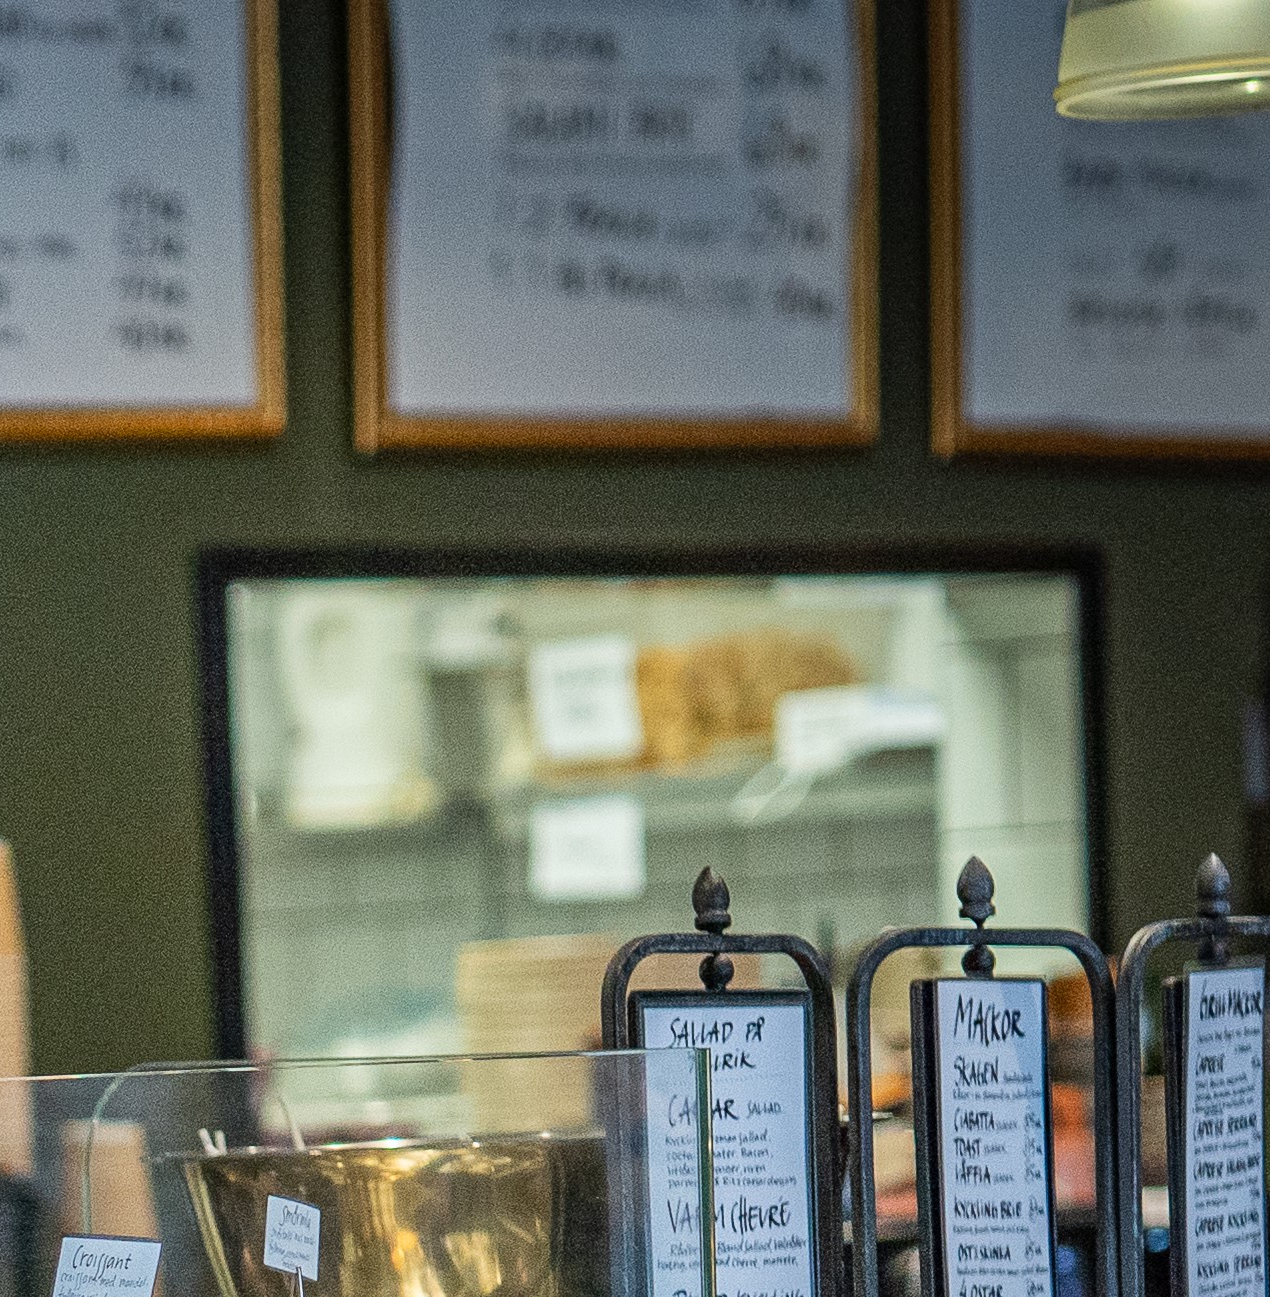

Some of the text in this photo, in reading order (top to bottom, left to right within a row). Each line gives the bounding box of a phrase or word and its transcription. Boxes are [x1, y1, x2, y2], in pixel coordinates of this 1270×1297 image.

[670, 1017, 765, 1049] SALLAD PÅ
[954, 993, 1025, 1047] MACKOR
[72, 1245, 132, 1280] Croissant
